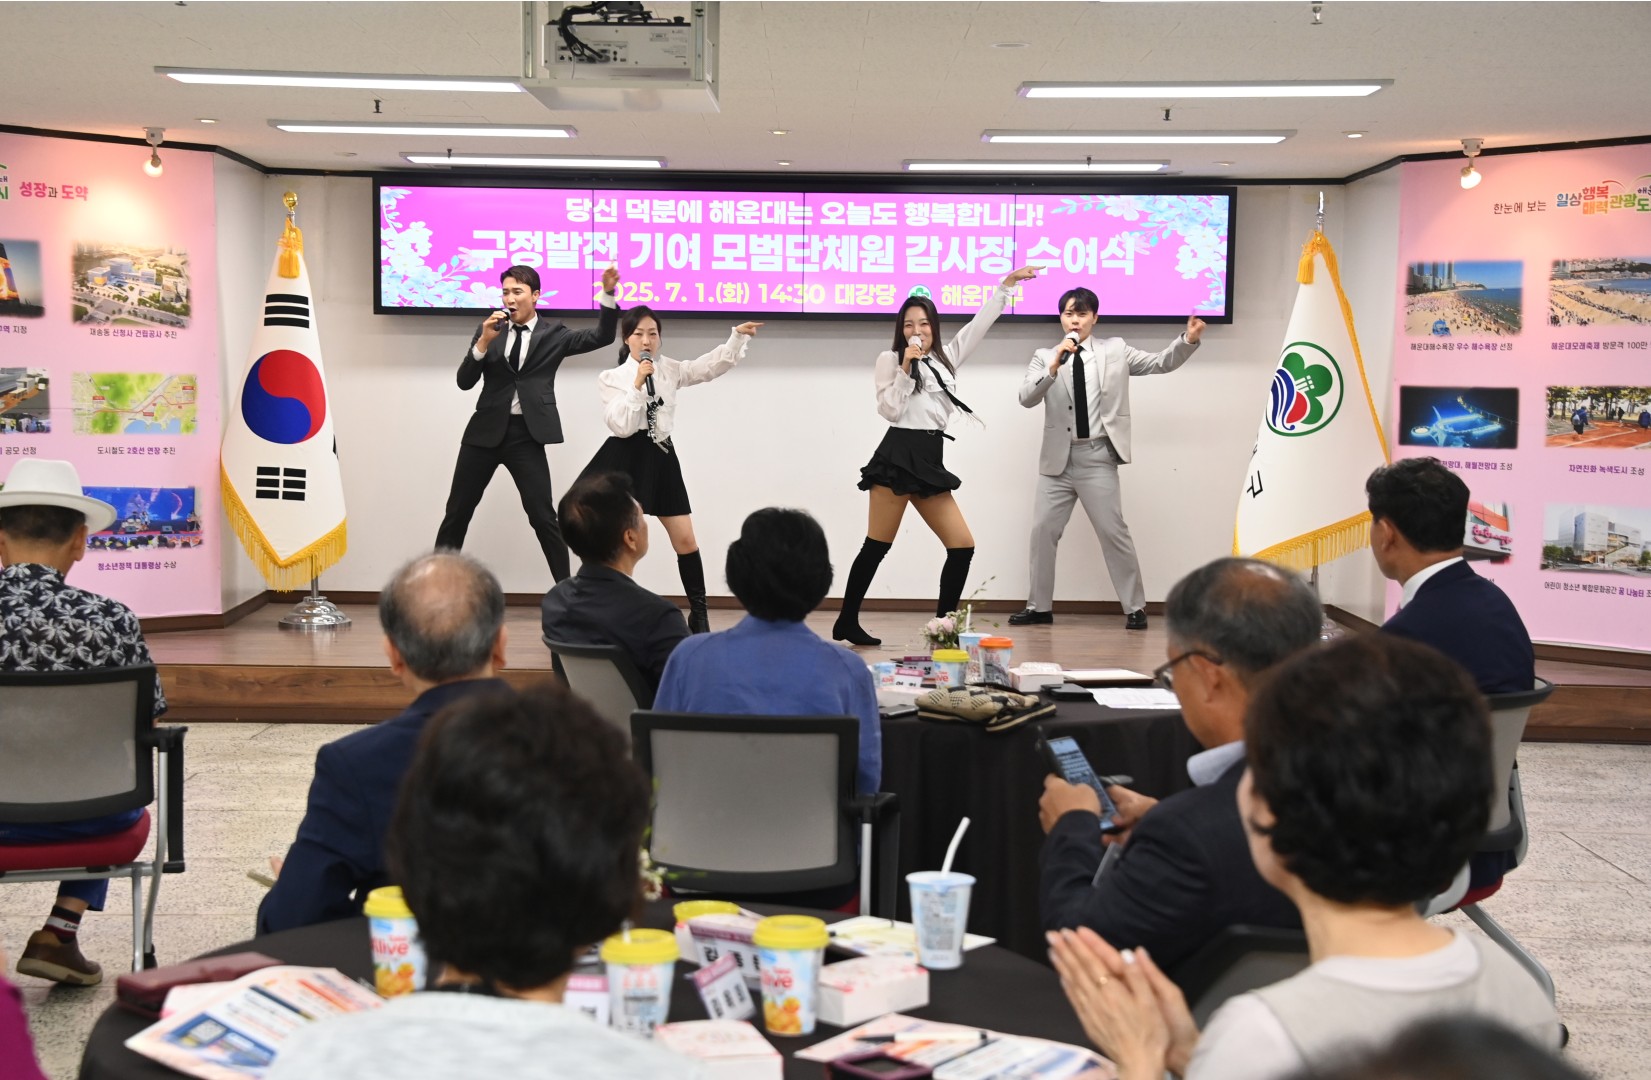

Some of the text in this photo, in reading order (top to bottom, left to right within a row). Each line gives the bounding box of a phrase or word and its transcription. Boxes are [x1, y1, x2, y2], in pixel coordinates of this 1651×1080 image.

[20, 181, 88, 201] 성장과 도약
[1582, 186, 1608, 200] 행복
[1494, 200, 1546, 214] 한눈에 보는
[1636, 198, 1651, 212] 도
[566, 198, 1044, 227] 당신 덕분에 해운대는 오늘도 행복합니다!
[470, 230, 1136, 276] 구정발전 기여 모범단체원 감사장 수여식
[665, 282, 688, 302] 7.
[758, 283, 825, 304] 14:30
[835, 284, 896, 306] 대강당
[13, 326, 27, 334] 지정
[112, 328, 133, 337] 신청사
[164, 330, 177, 339] 추진
[1500, 462, 1513, 471] 조성
[1569, 464, 1596, 473] 자연친화
[1630, 466, 1645, 476] 조성
